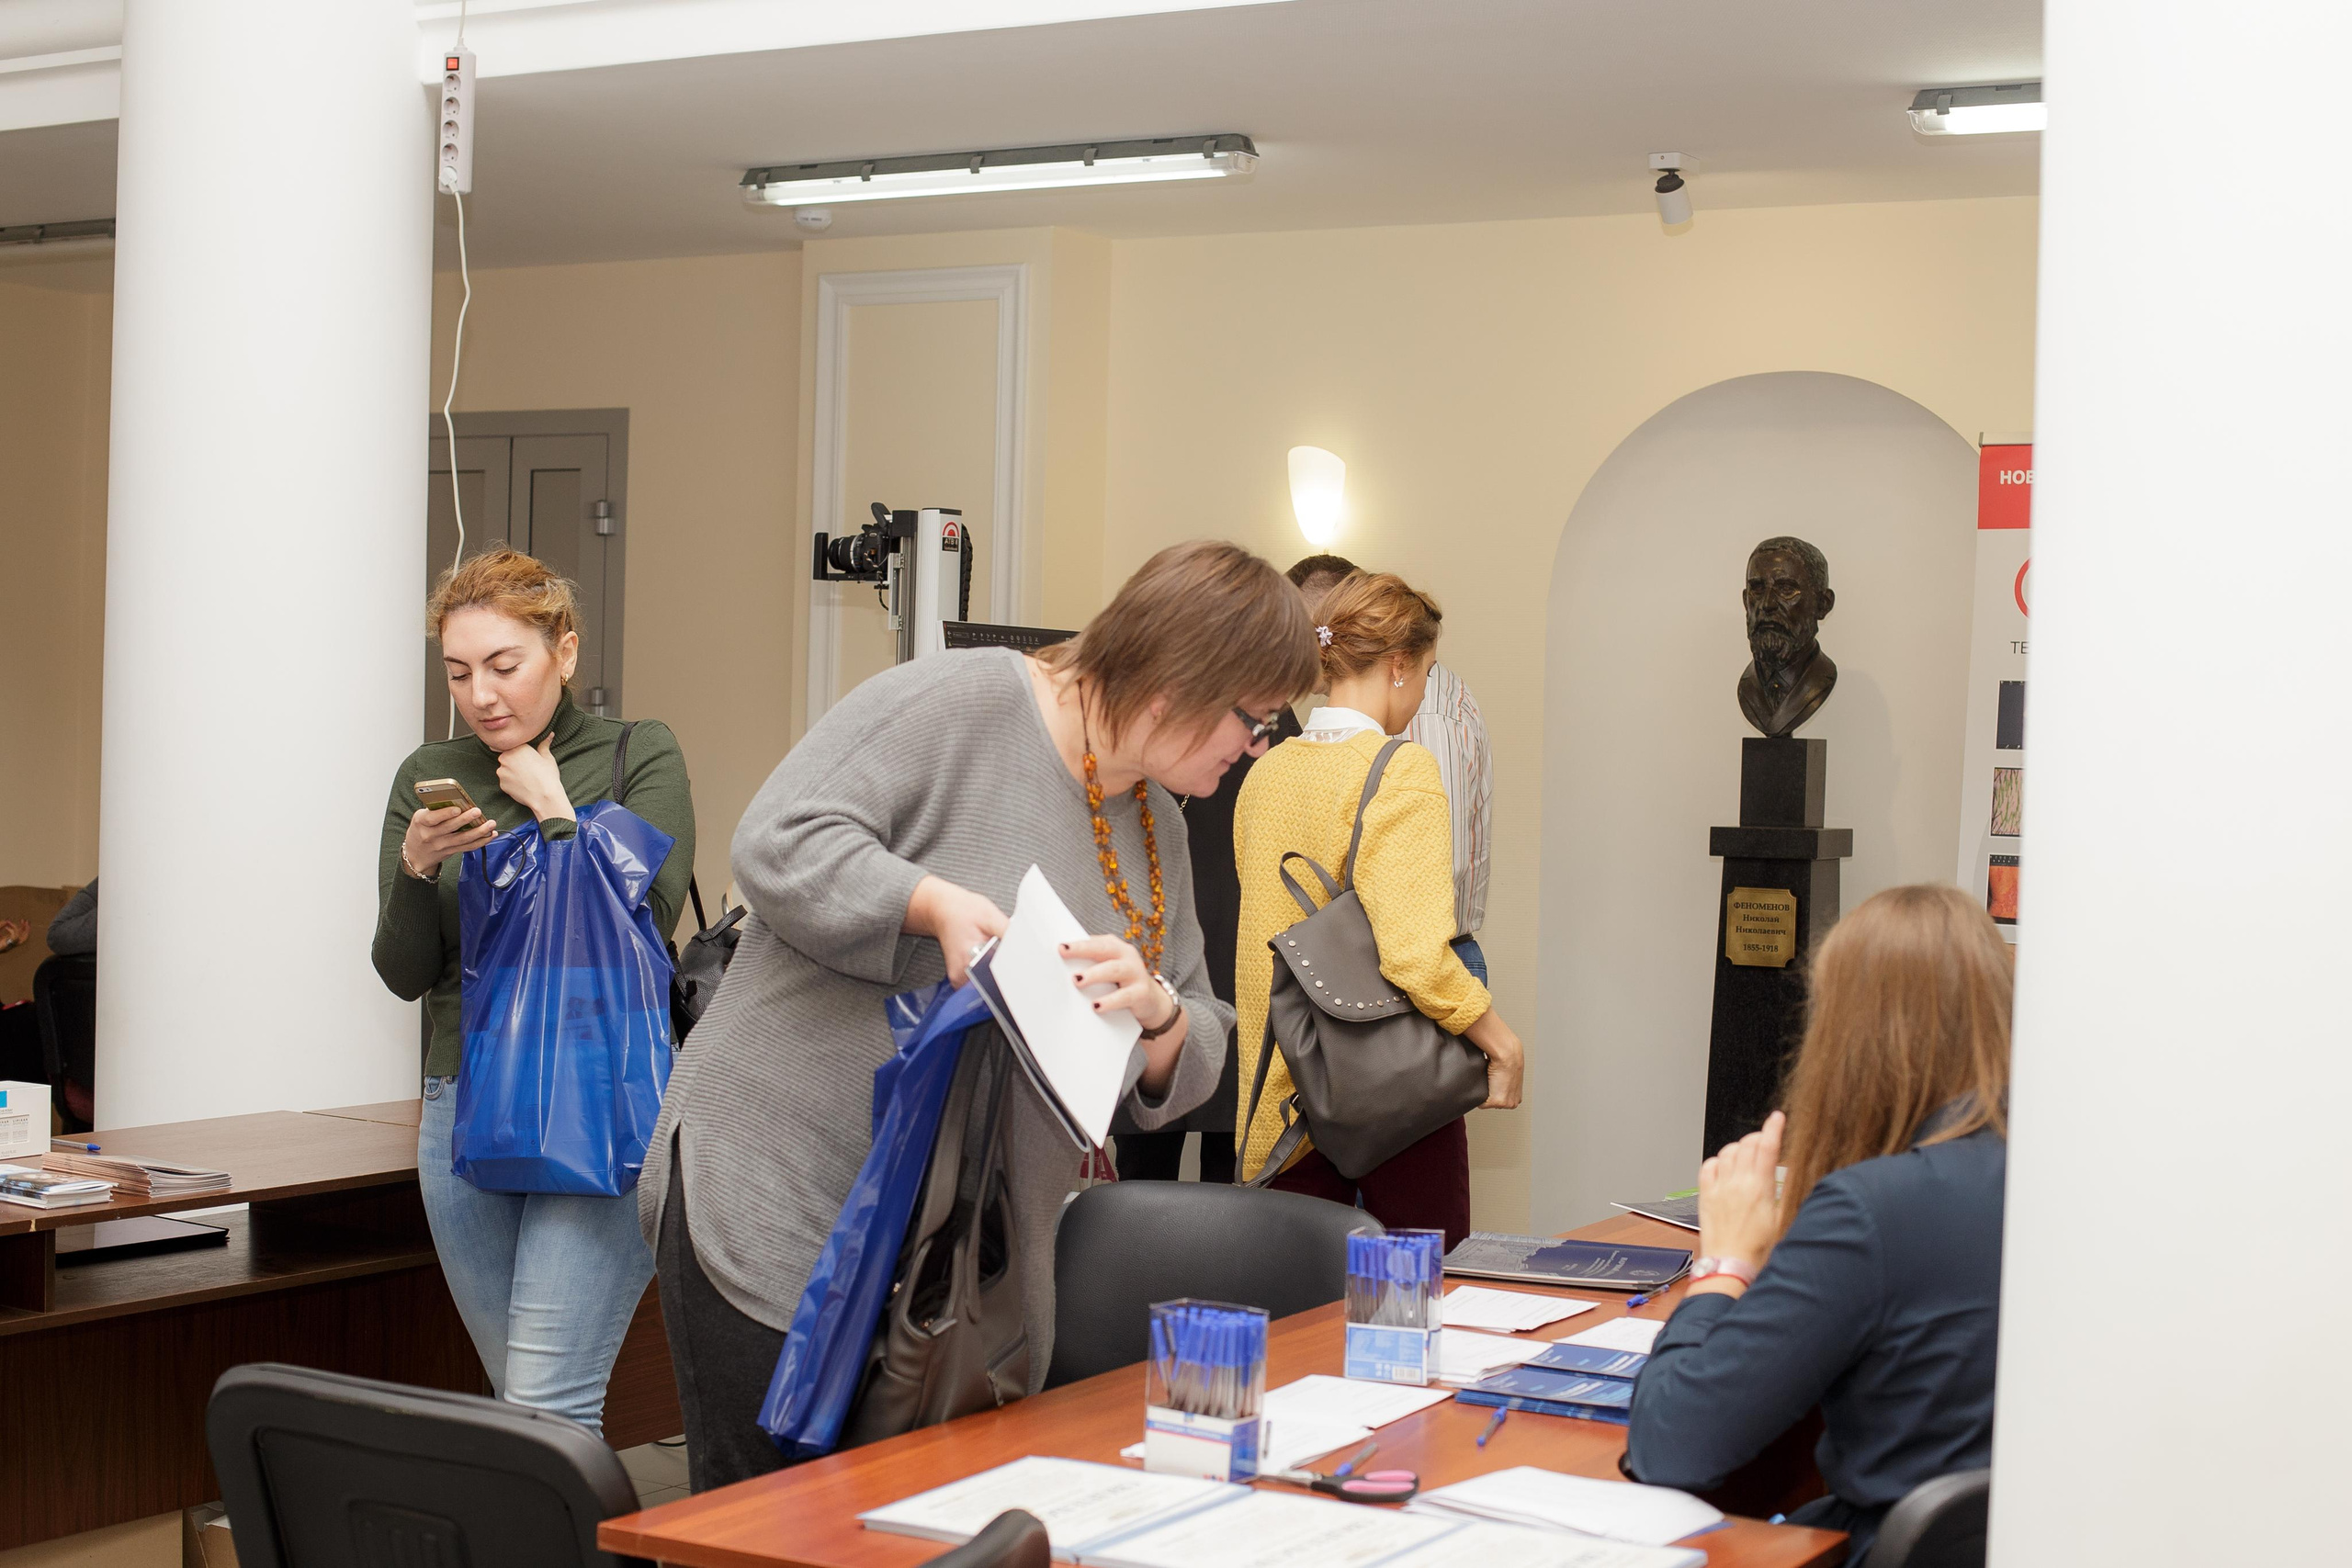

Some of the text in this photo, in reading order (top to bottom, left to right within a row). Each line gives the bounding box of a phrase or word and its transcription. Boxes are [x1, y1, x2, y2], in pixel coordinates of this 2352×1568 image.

[1733, 902, 1791, 911] ФЕНОМЕНОВ
[1743, 914, 1780, 923] Николай
[1736, 926, 1786, 935] Николаевич
[1743, 943, 1779, 953] 1855-1918
